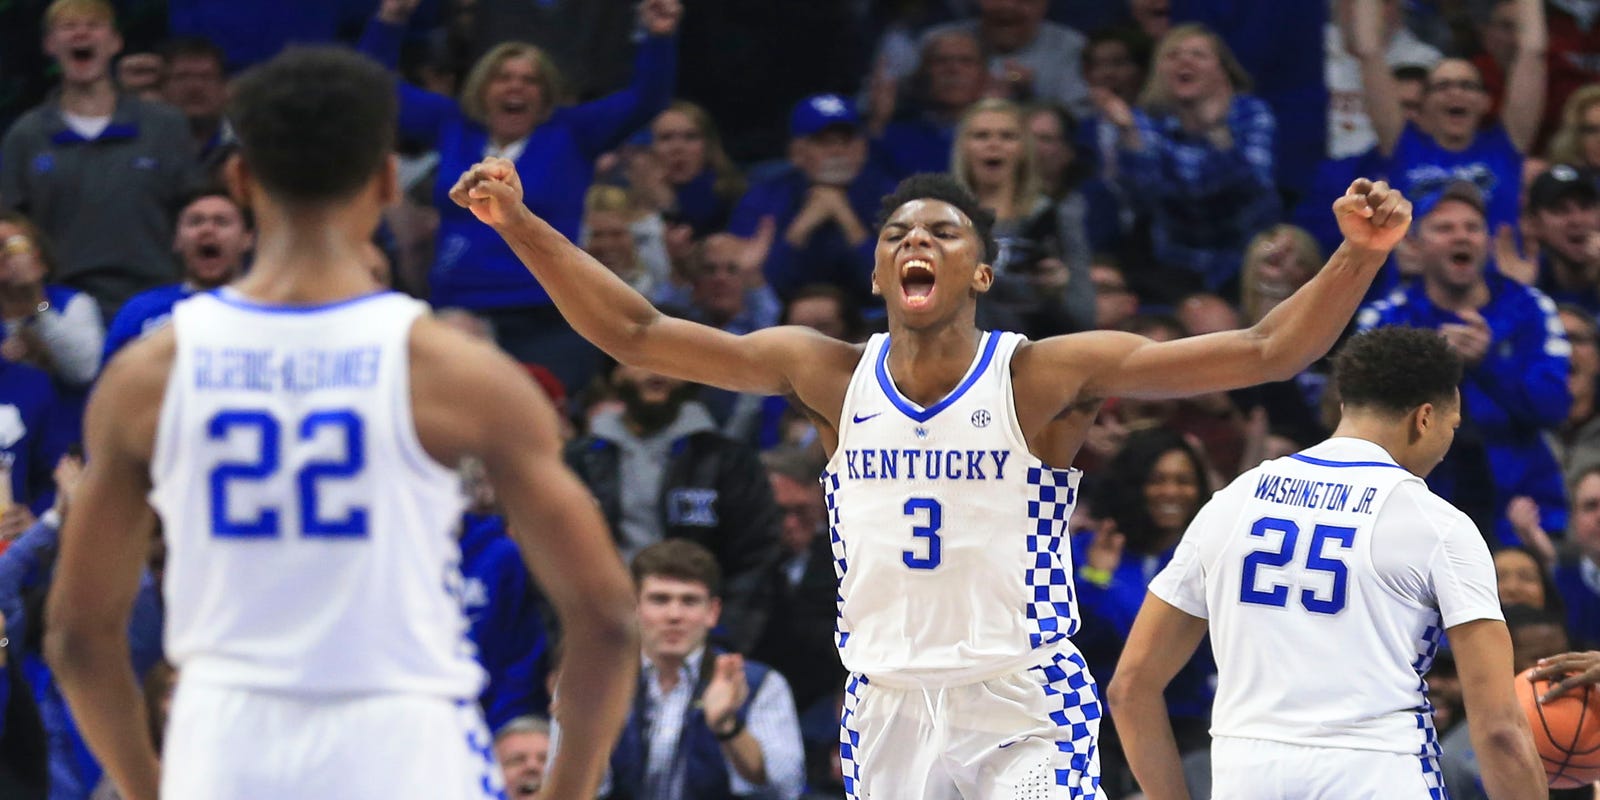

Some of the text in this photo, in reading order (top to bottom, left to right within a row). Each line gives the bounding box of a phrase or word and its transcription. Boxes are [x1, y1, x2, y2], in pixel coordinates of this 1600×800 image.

[972, 410, 991, 427] SEC
[207, 409, 369, 538] 22
[845, 449, 1010, 480] KENTUCKY
[1254, 473, 1378, 515] WASHINGTON JR.
[902, 497, 942, 570] 3
[1239, 516, 1358, 615] 25
